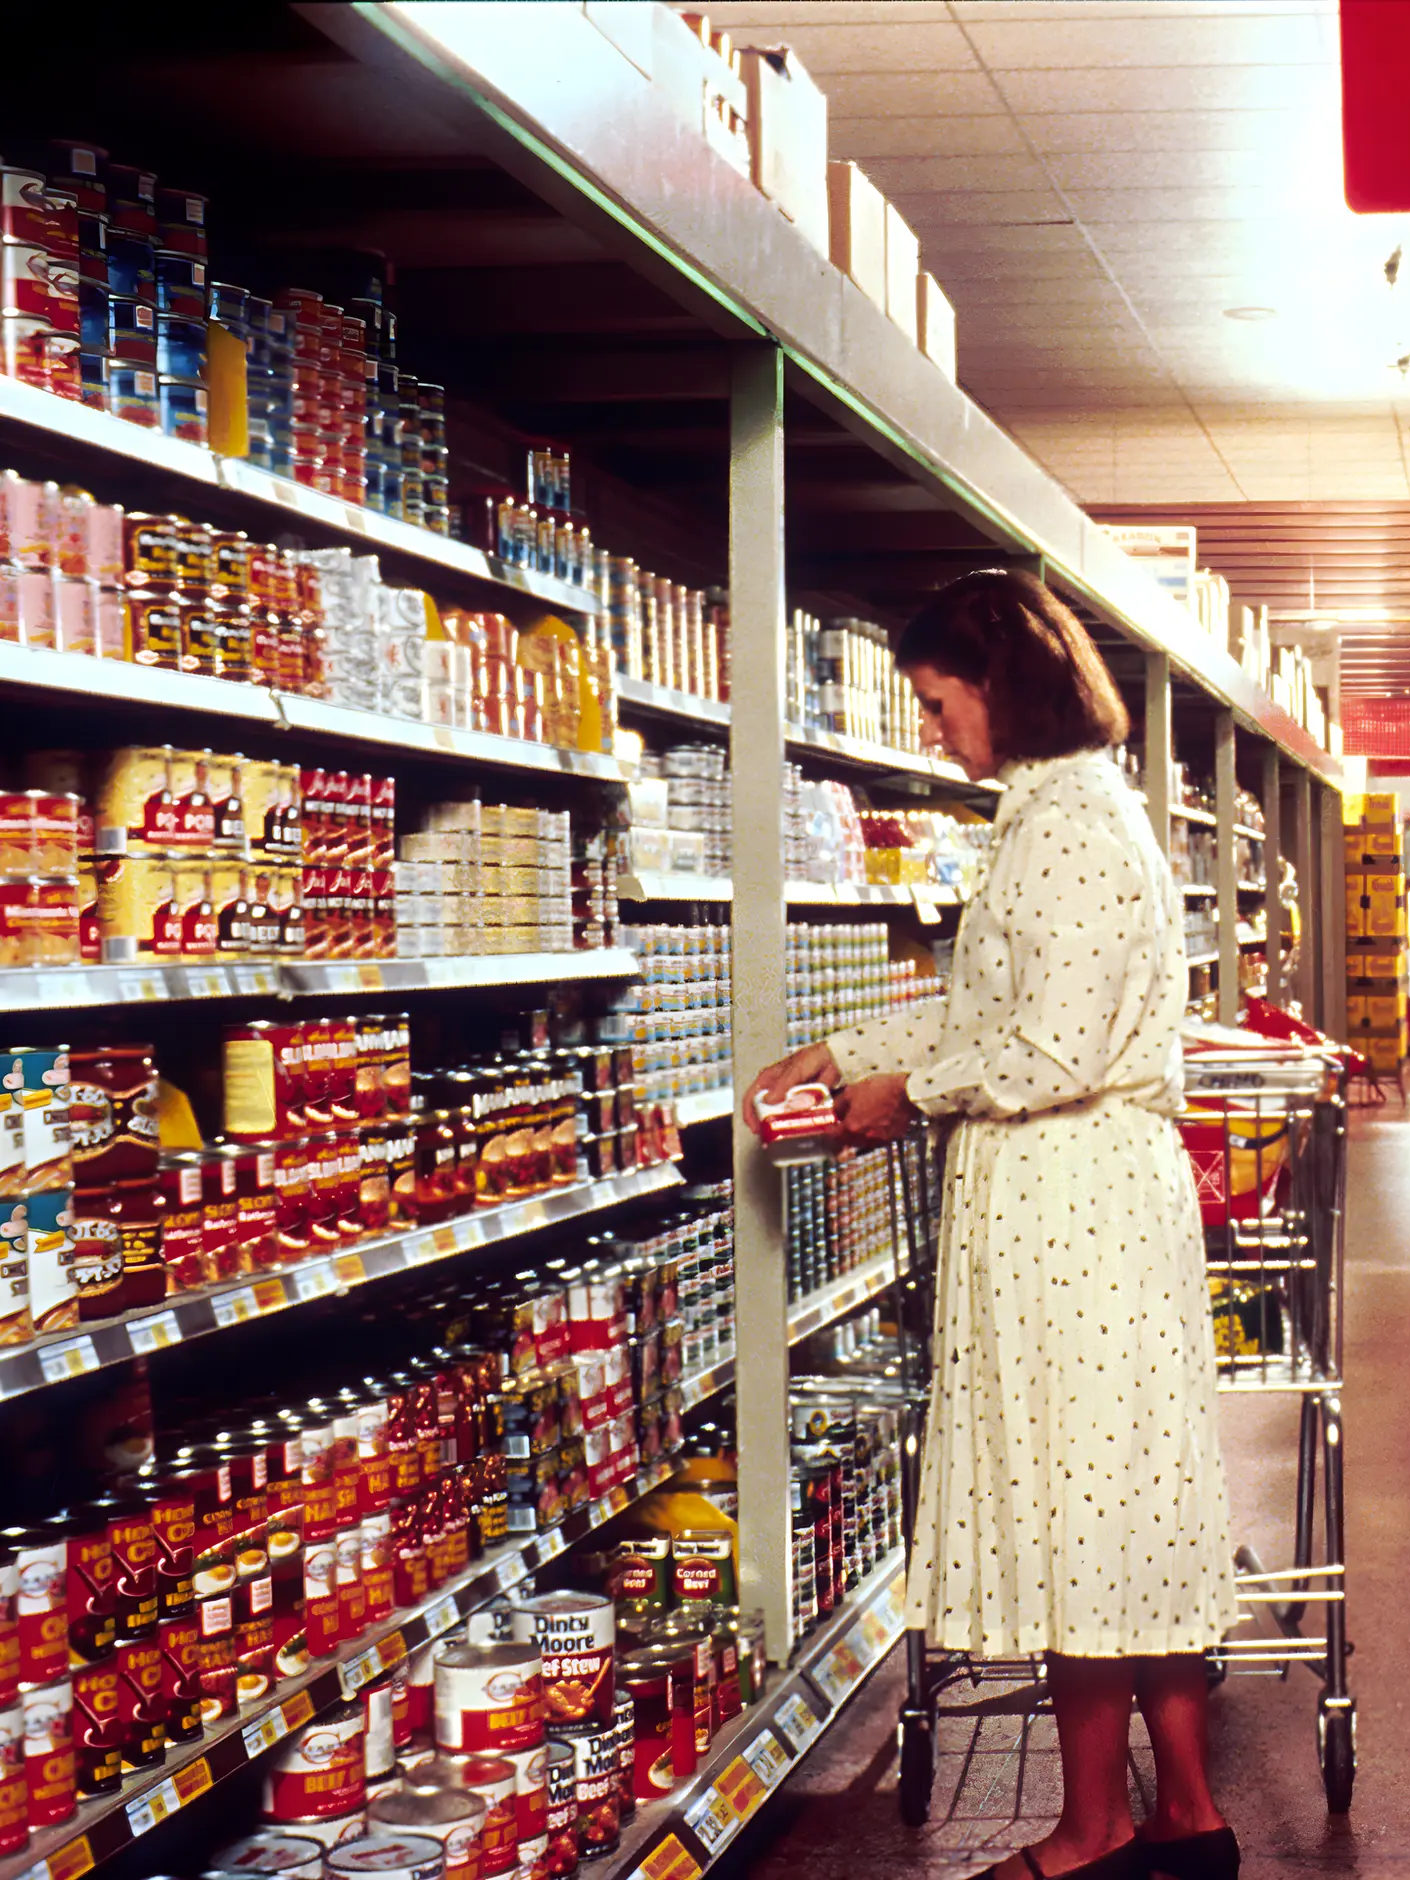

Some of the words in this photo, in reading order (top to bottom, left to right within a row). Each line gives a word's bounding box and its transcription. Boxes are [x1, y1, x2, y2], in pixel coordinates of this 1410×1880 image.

[676, 1568, 717, 1580] Corned
[534, 1615, 589, 1633] Dinty
[529, 1634, 595, 1655] Moore
[542, 1659, 560, 1678] ef
[560, 1656, 600, 1676] Stew
